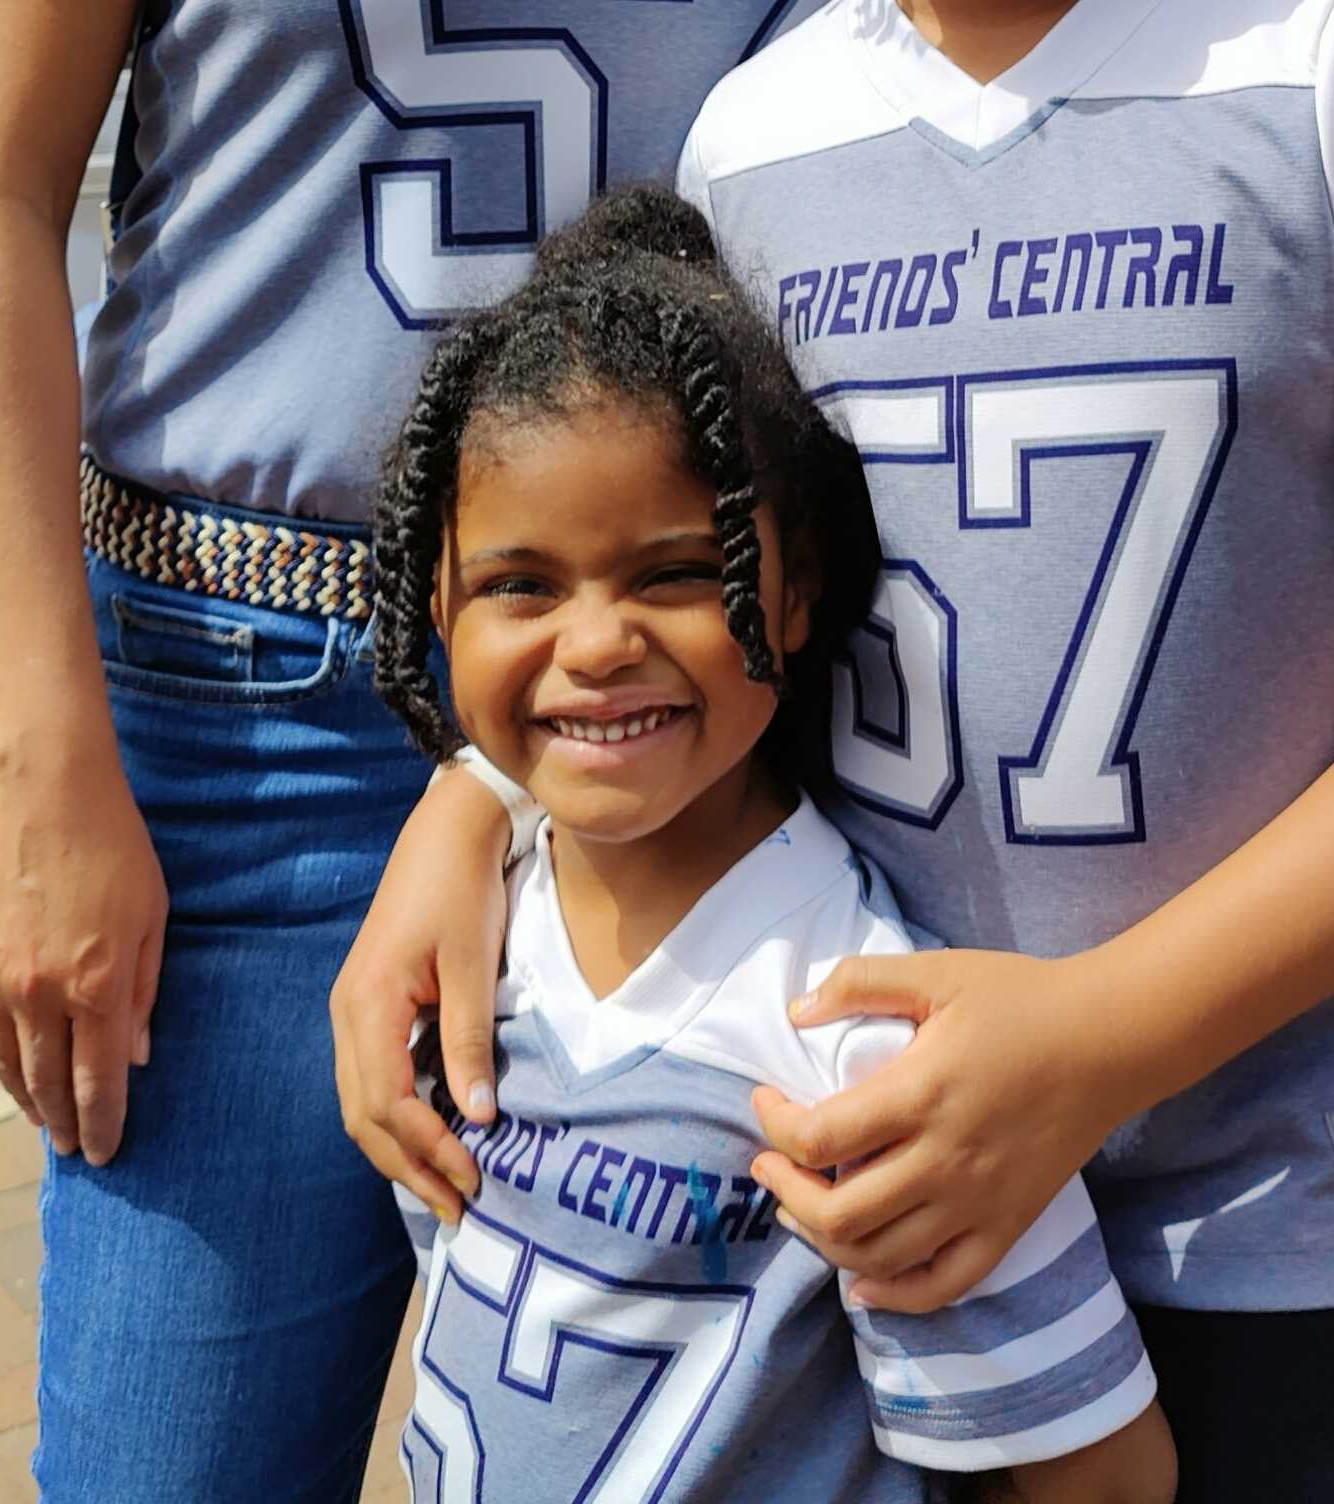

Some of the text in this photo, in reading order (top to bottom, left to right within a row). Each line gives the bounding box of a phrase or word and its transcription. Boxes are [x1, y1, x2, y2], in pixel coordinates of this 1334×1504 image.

[778, 223, 1234, 346] FRIENDS' CENTRAL
[810, 358, 1238, 844] 57
[558, 1139, 775, 1245] CENTRAL
[398, 1199, 757, 1504] 57
